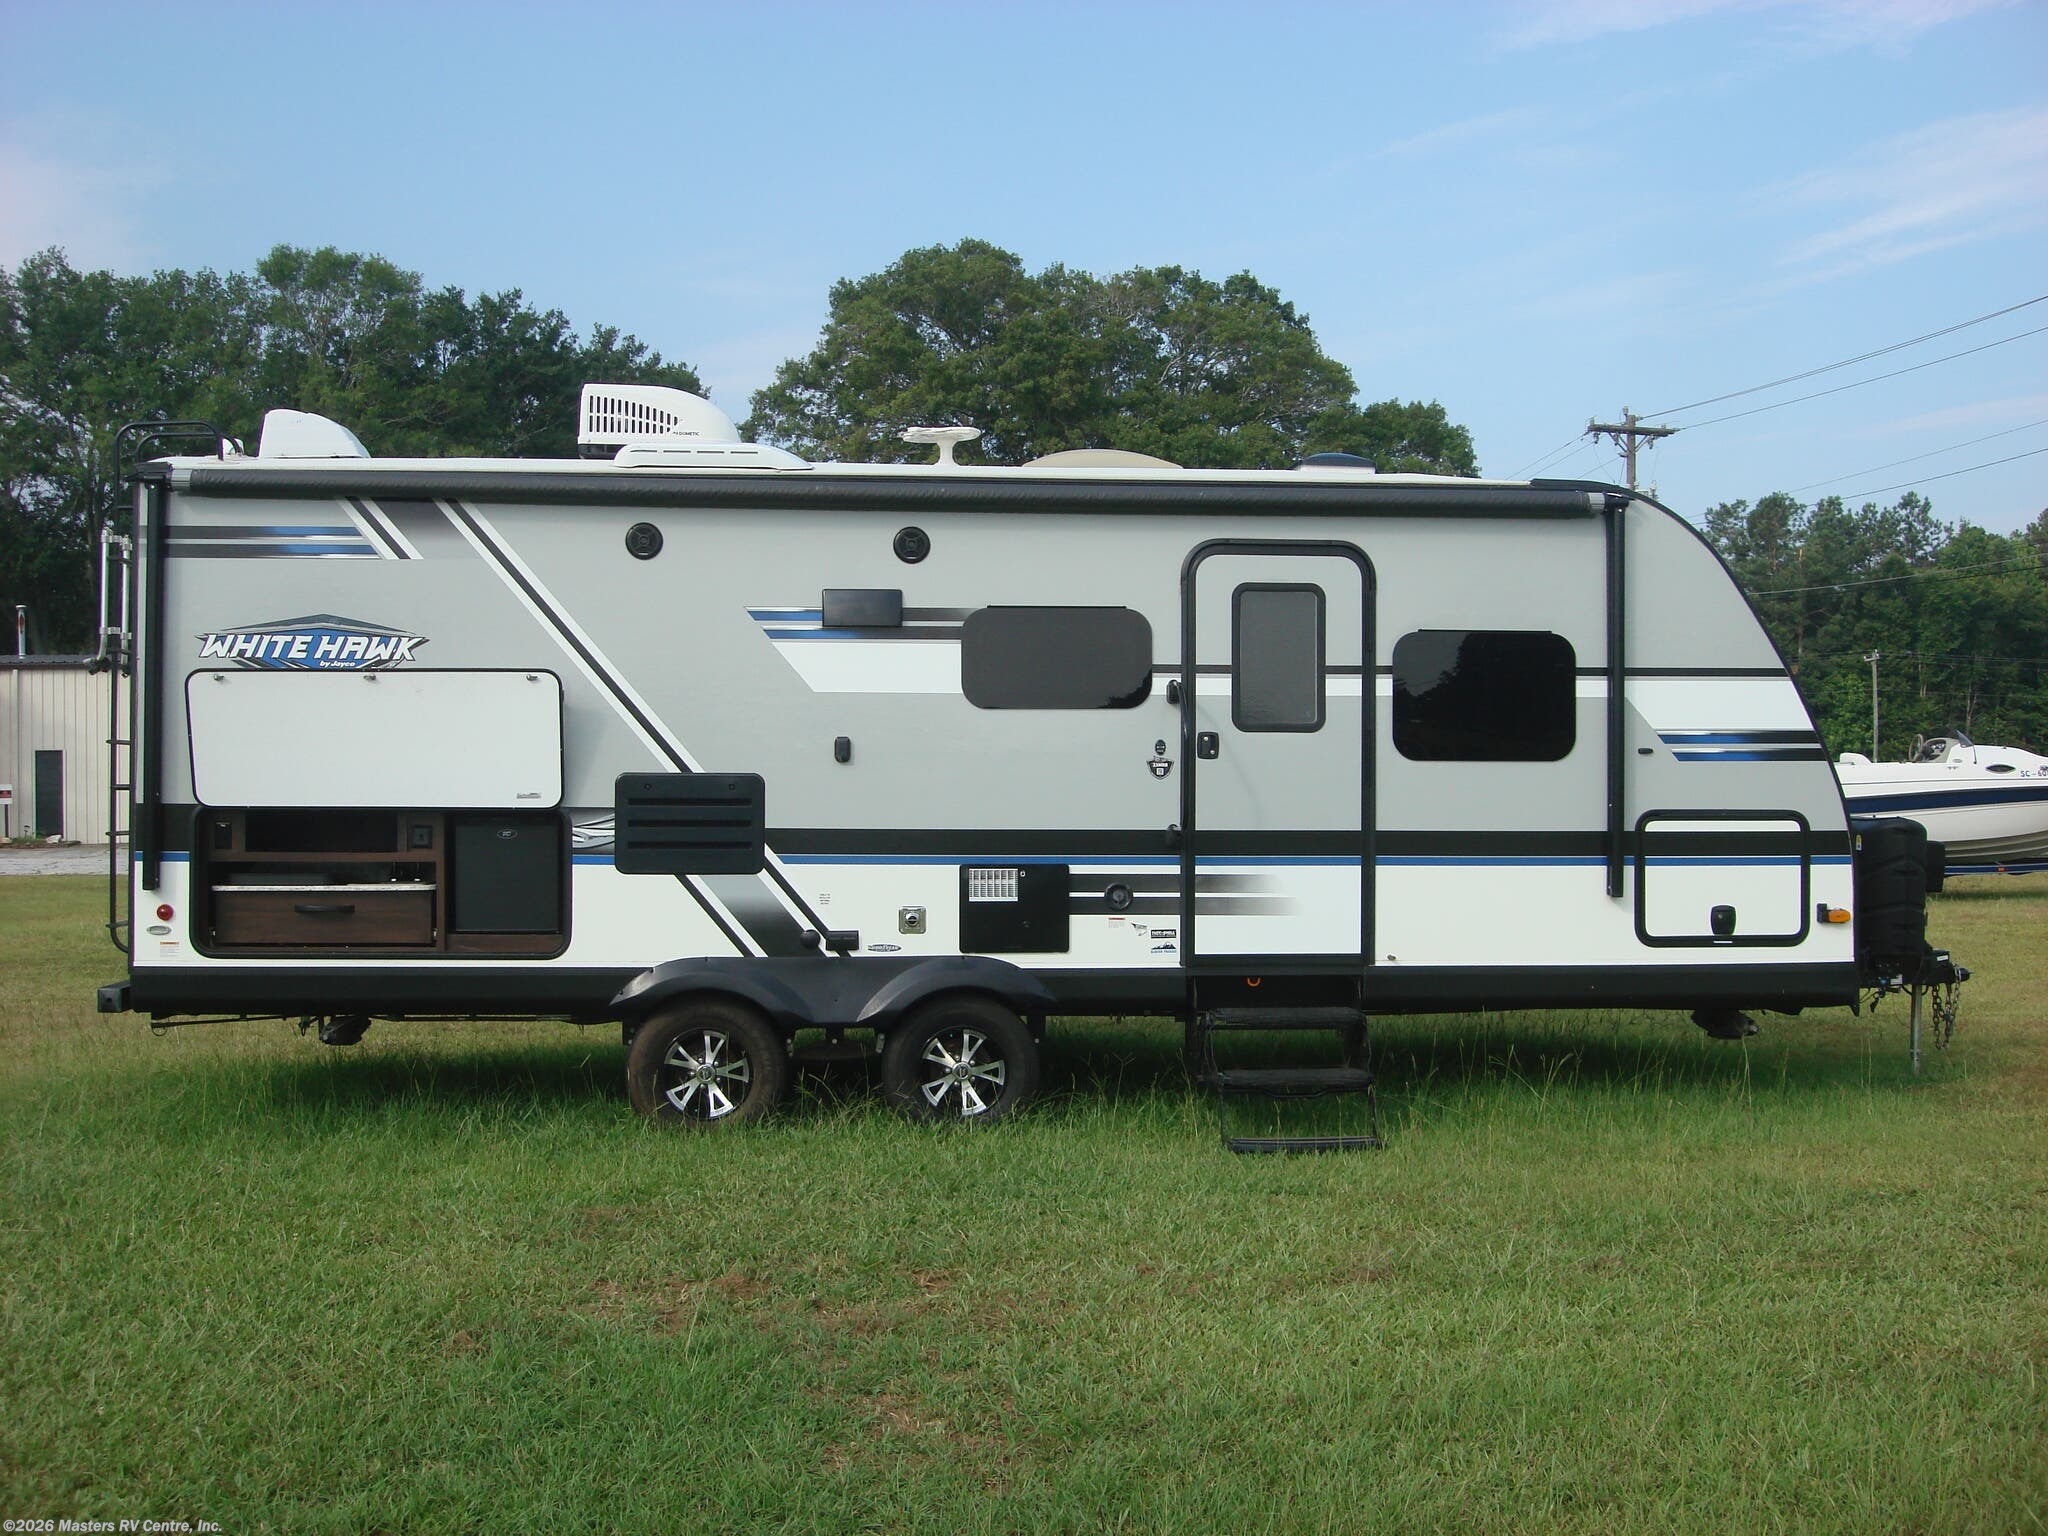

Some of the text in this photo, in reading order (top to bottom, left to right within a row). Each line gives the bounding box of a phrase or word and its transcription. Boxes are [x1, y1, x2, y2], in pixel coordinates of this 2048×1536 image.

[200, 634, 423, 662] WHITE HAWK
[319, 660, 356, 668] by Jayco
